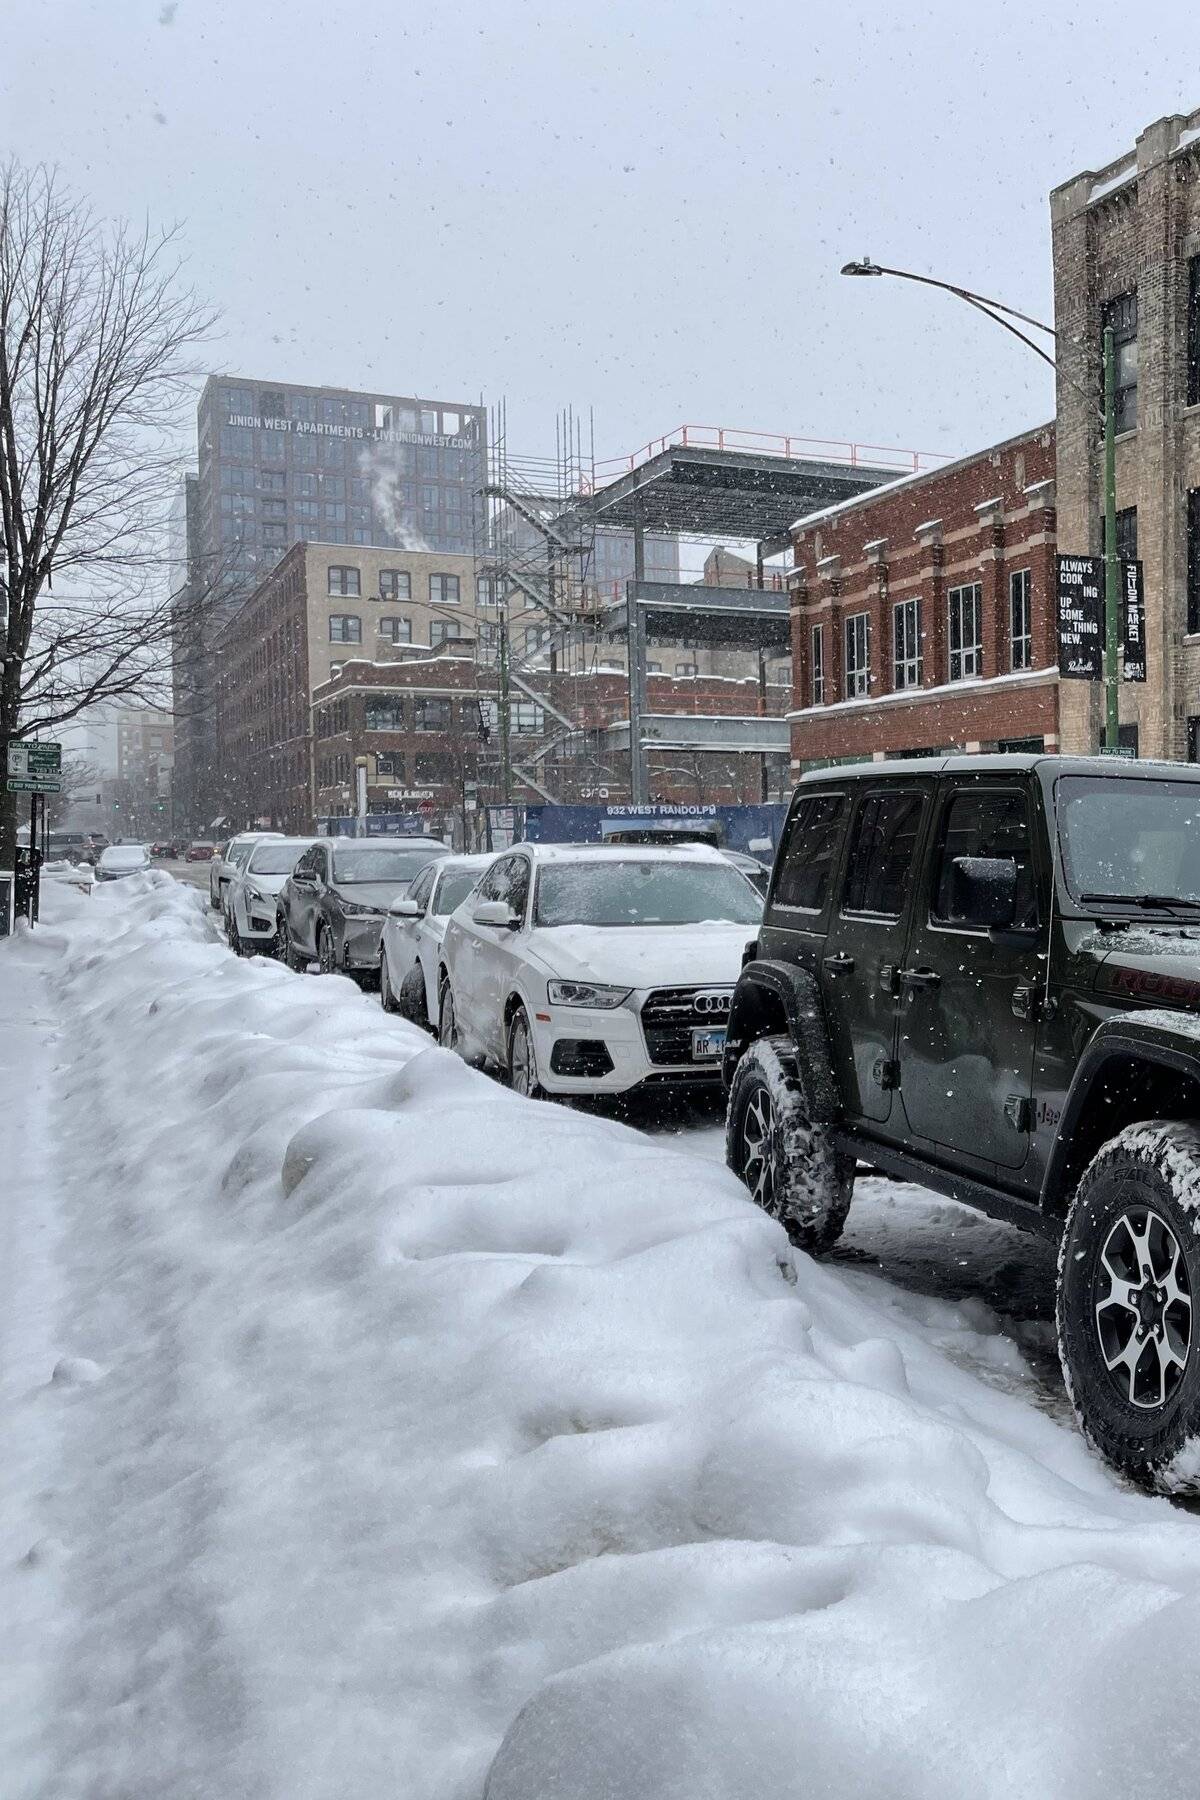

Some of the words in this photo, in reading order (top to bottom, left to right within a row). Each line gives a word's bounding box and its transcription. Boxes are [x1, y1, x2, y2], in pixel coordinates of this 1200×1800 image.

[229, 414, 261, 428] UNION
[264, 418, 293, 432] WEST
[296, 421, 364, 439] APARTMENTS
[1060, 560, 1093, 573] ALWAYS
[1060, 573, 1083, 585] COOK
[1127, 565, 1138, 602] FULTON
[1083, 586, 1098, 598] ING
[1060, 597, 1072, 608] UP
[1060, 609, 1084, 621] SOME
[1073, 621, 1098, 634] THING
[1128, 608, 1139, 643] MARKET
[1060, 633, 1083, 645] NEW.
[627, 806, 657, 815] WEST
